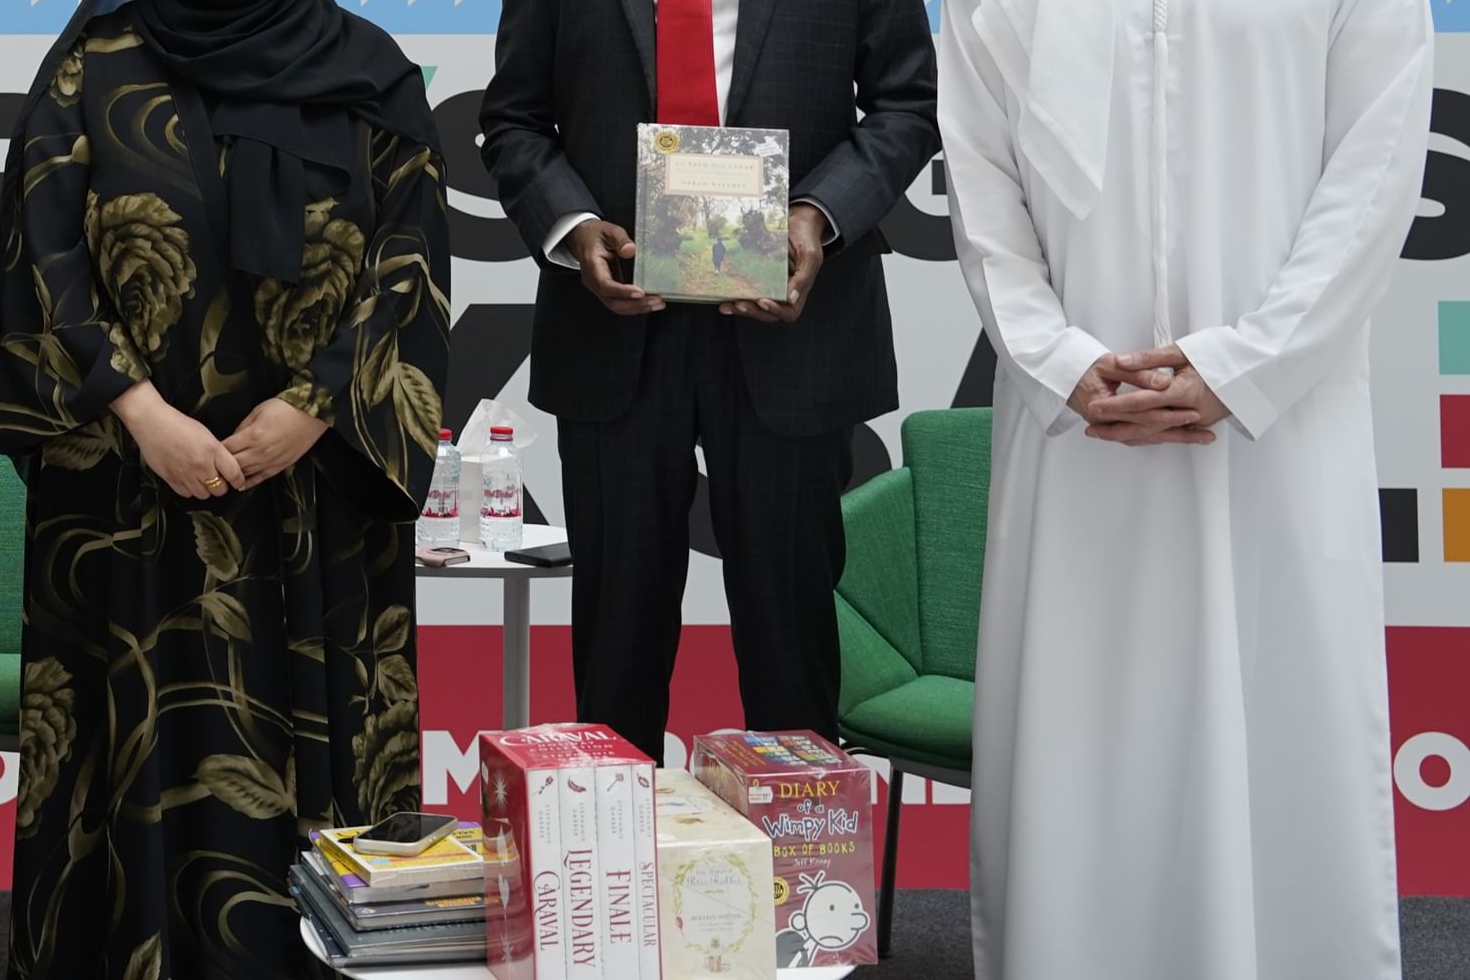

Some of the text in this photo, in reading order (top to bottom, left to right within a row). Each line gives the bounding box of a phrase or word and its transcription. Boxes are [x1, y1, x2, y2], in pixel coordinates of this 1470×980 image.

[499, 731, 617, 747] CARAVAL
[780, 780, 841, 798] DIARY
[796, 799, 824, 813] of a
[762, 809, 859, 842] Wimpy Kid
[802, 845, 813, 855] OF
[820, 842, 856, 856] BOOKS
[533, 870, 560, 951] CARAVAL
[563, 848, 596, 968] LEGENDARY
[605, 870, 632, 945] FINALE
[640, 861, 658, 948] SPECTACULAR
